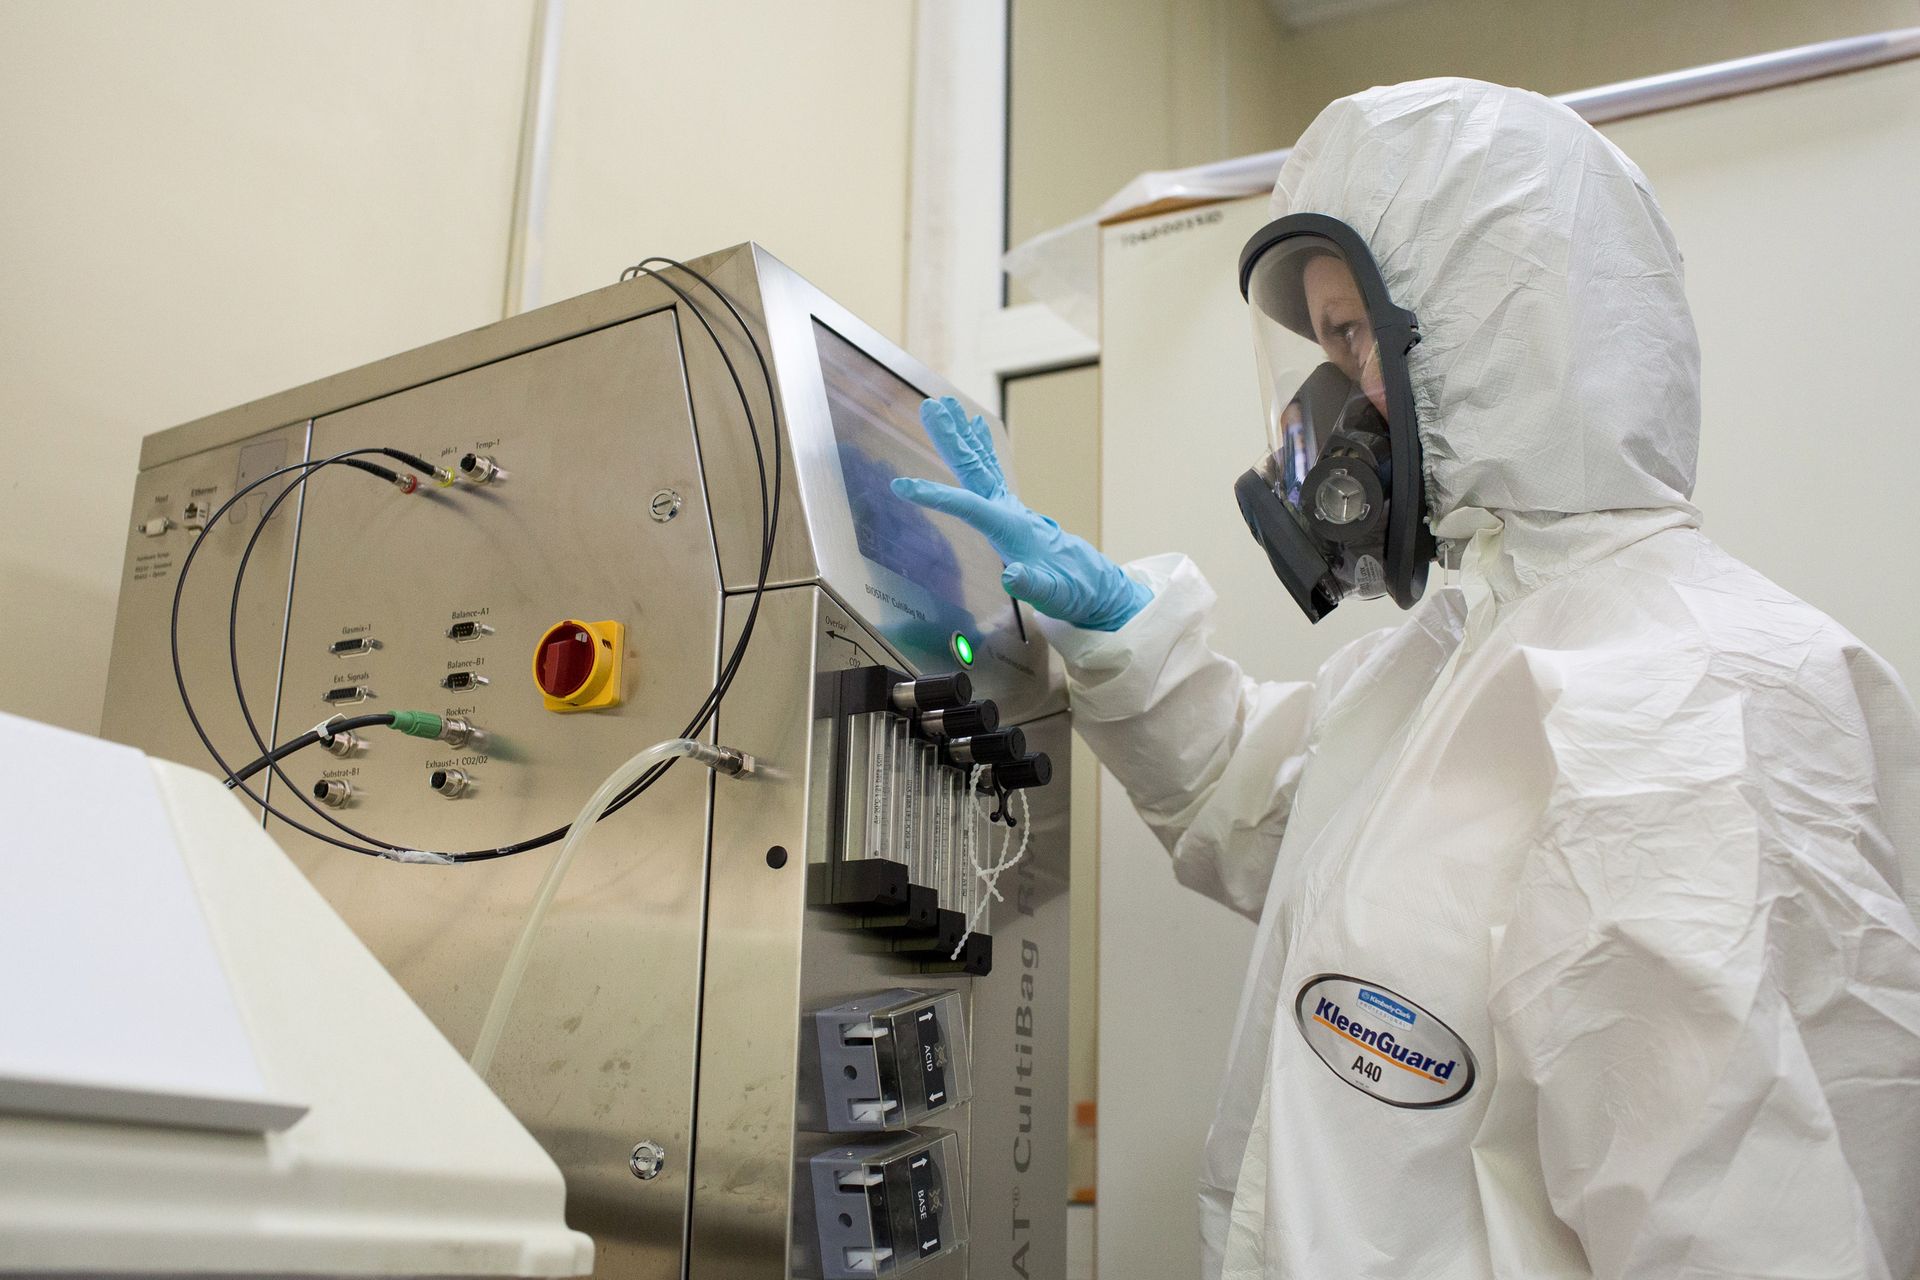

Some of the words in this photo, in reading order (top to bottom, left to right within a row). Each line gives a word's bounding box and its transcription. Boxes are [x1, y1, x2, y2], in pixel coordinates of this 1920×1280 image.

[476, 438, 500, 449] Temp-1
[441, 447, 458, 457] pH-1
[451, 607, 490, 620] Balance-A1
[825, 615, 847, 633] Overlay
[447, 657, 485, 670] Balance-B1
[347, 671, 370, 683] Signals
[445, 706, 476, 717] Rocker-1
[425, 758, 459, 770] Exhaust-1
[461, 755, 488, 767] CO2/O2
[322, 767, 360, 779] Substrat-B1
[1315, 996, 1456, 1080] KleenGuard
[923, 1044, 933, 1072] ACID
[1013, 939, 1039, 1174] CultiBag
[1351, 1055, 1383, 1083] A40
[917, 1189, 928, 1220] BASE
